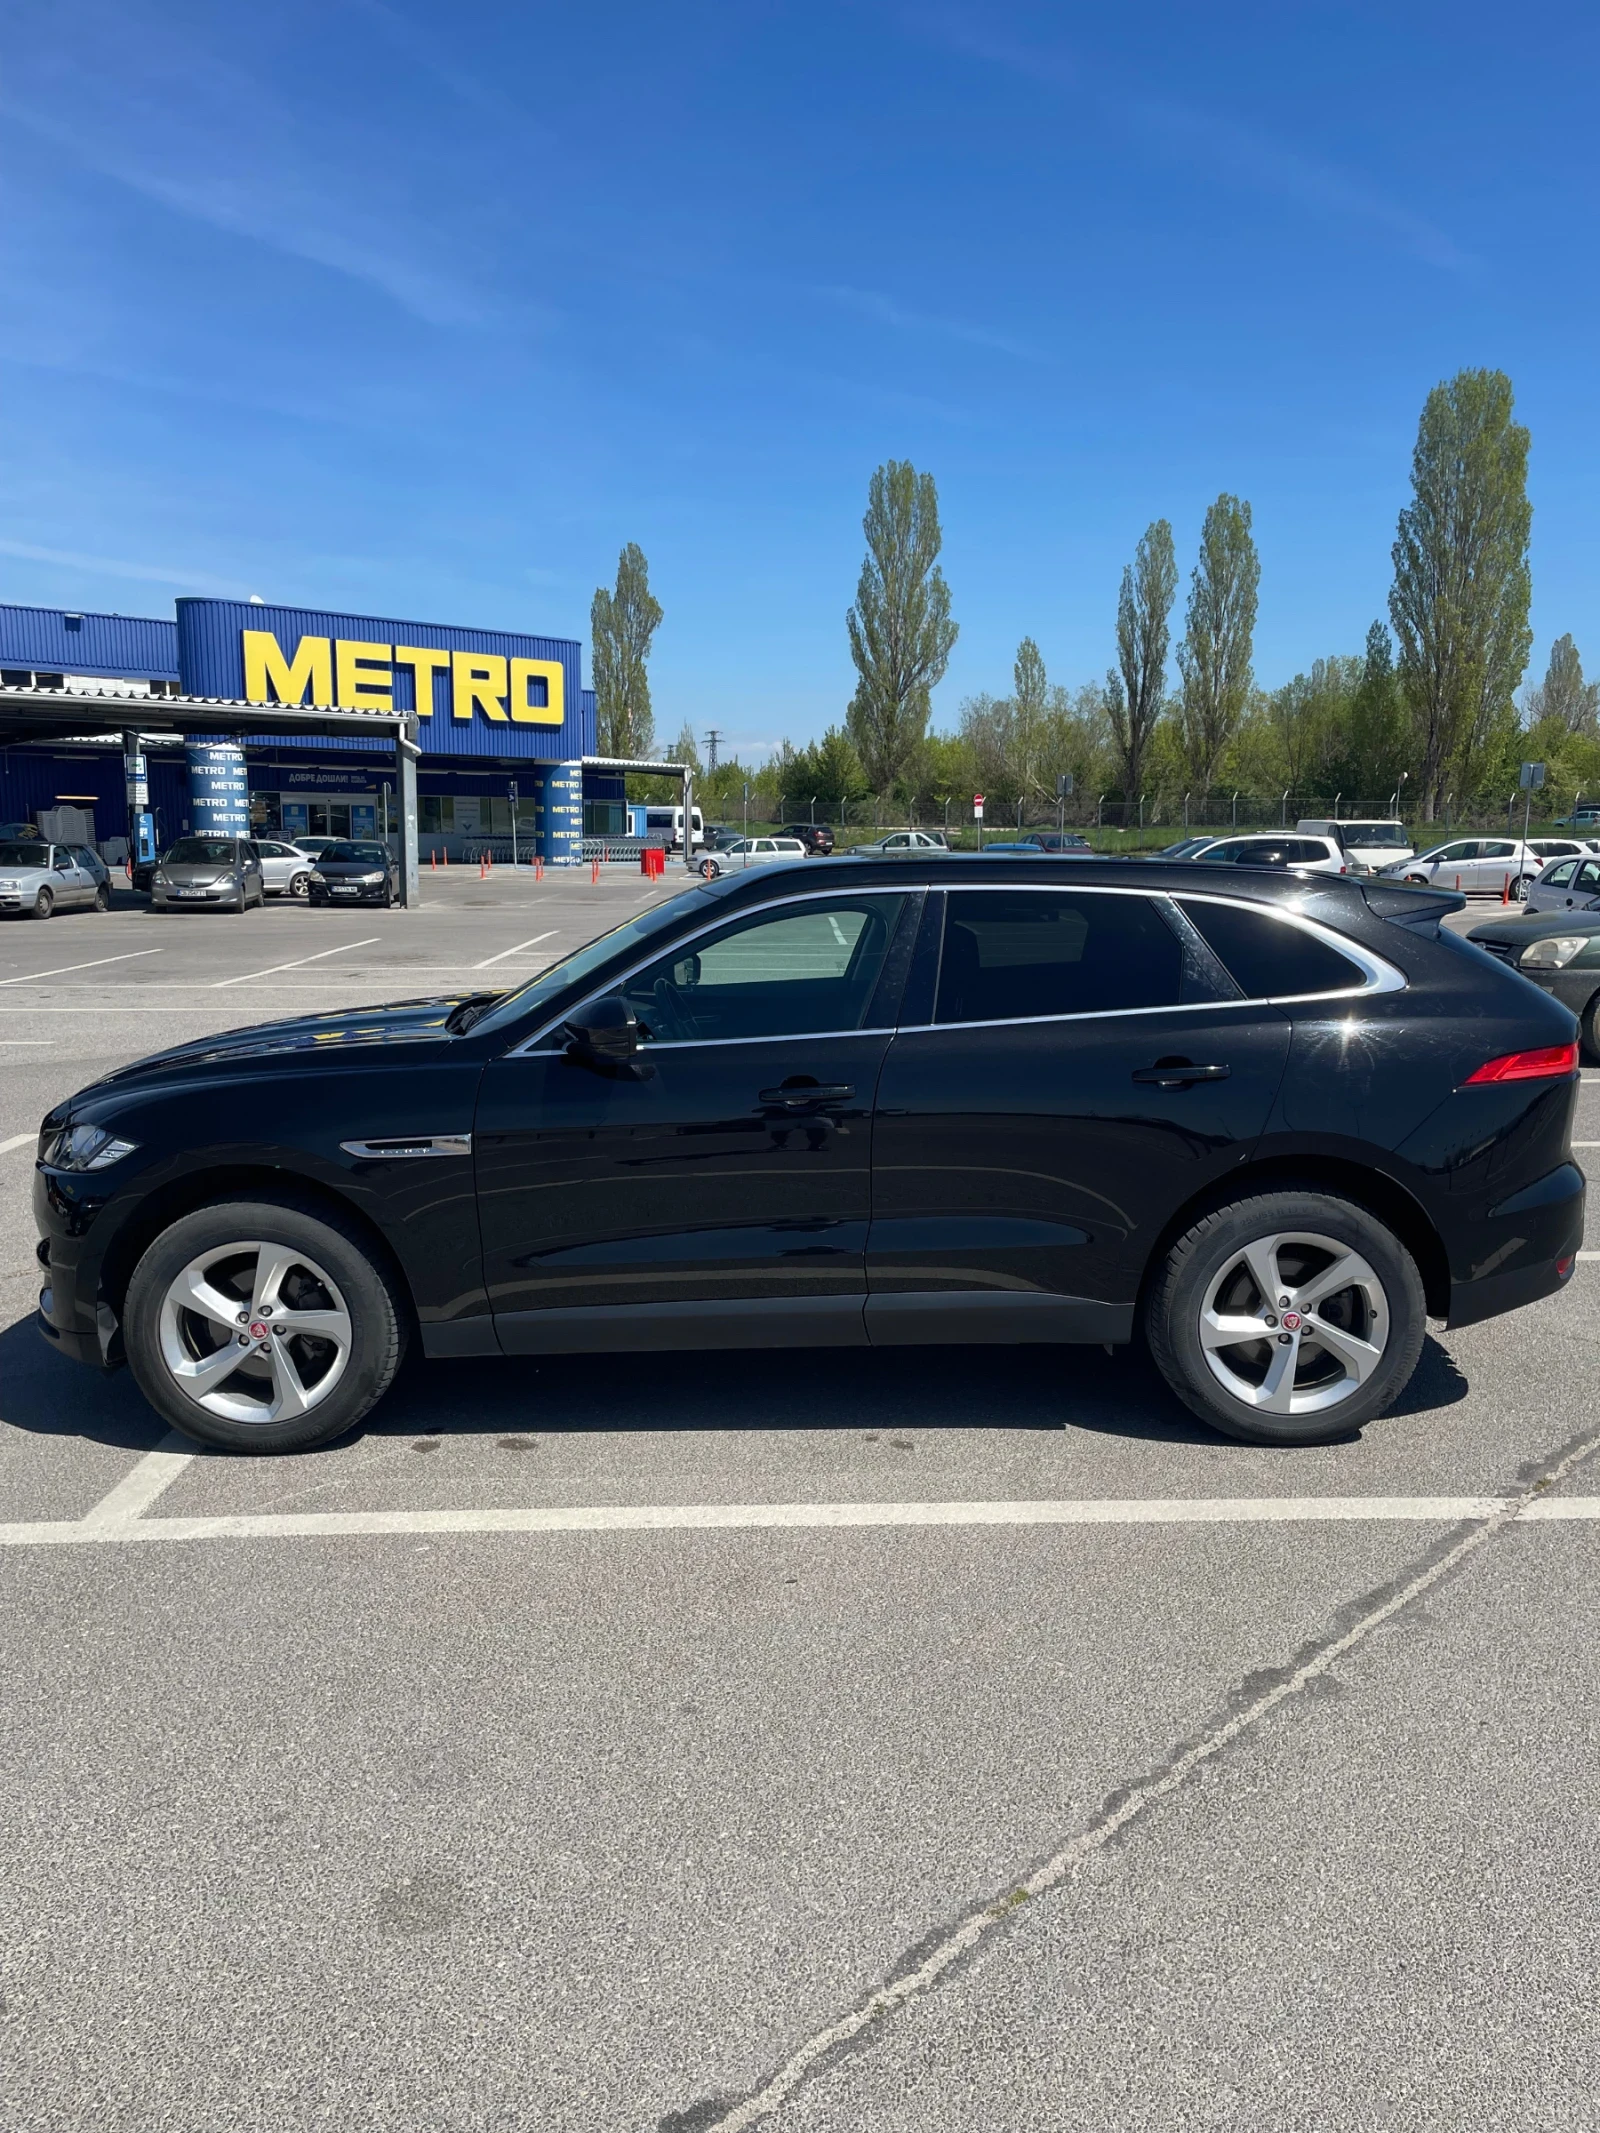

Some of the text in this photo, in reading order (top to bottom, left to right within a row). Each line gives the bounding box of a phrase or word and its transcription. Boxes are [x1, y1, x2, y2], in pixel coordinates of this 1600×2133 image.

[243, 630, 564, 725] METRO
[209, 752, 243, 761] METRO
[191, 766, 247, 776] METRO MET
[289, 773, 315, 783] ДОБРЕ
[211, 782, 245, 790] METRO
[193, 798, 249, 807] METRO MET
[213, 814, 246, 822] METRO
[195, 830, 229, 838] METRO
